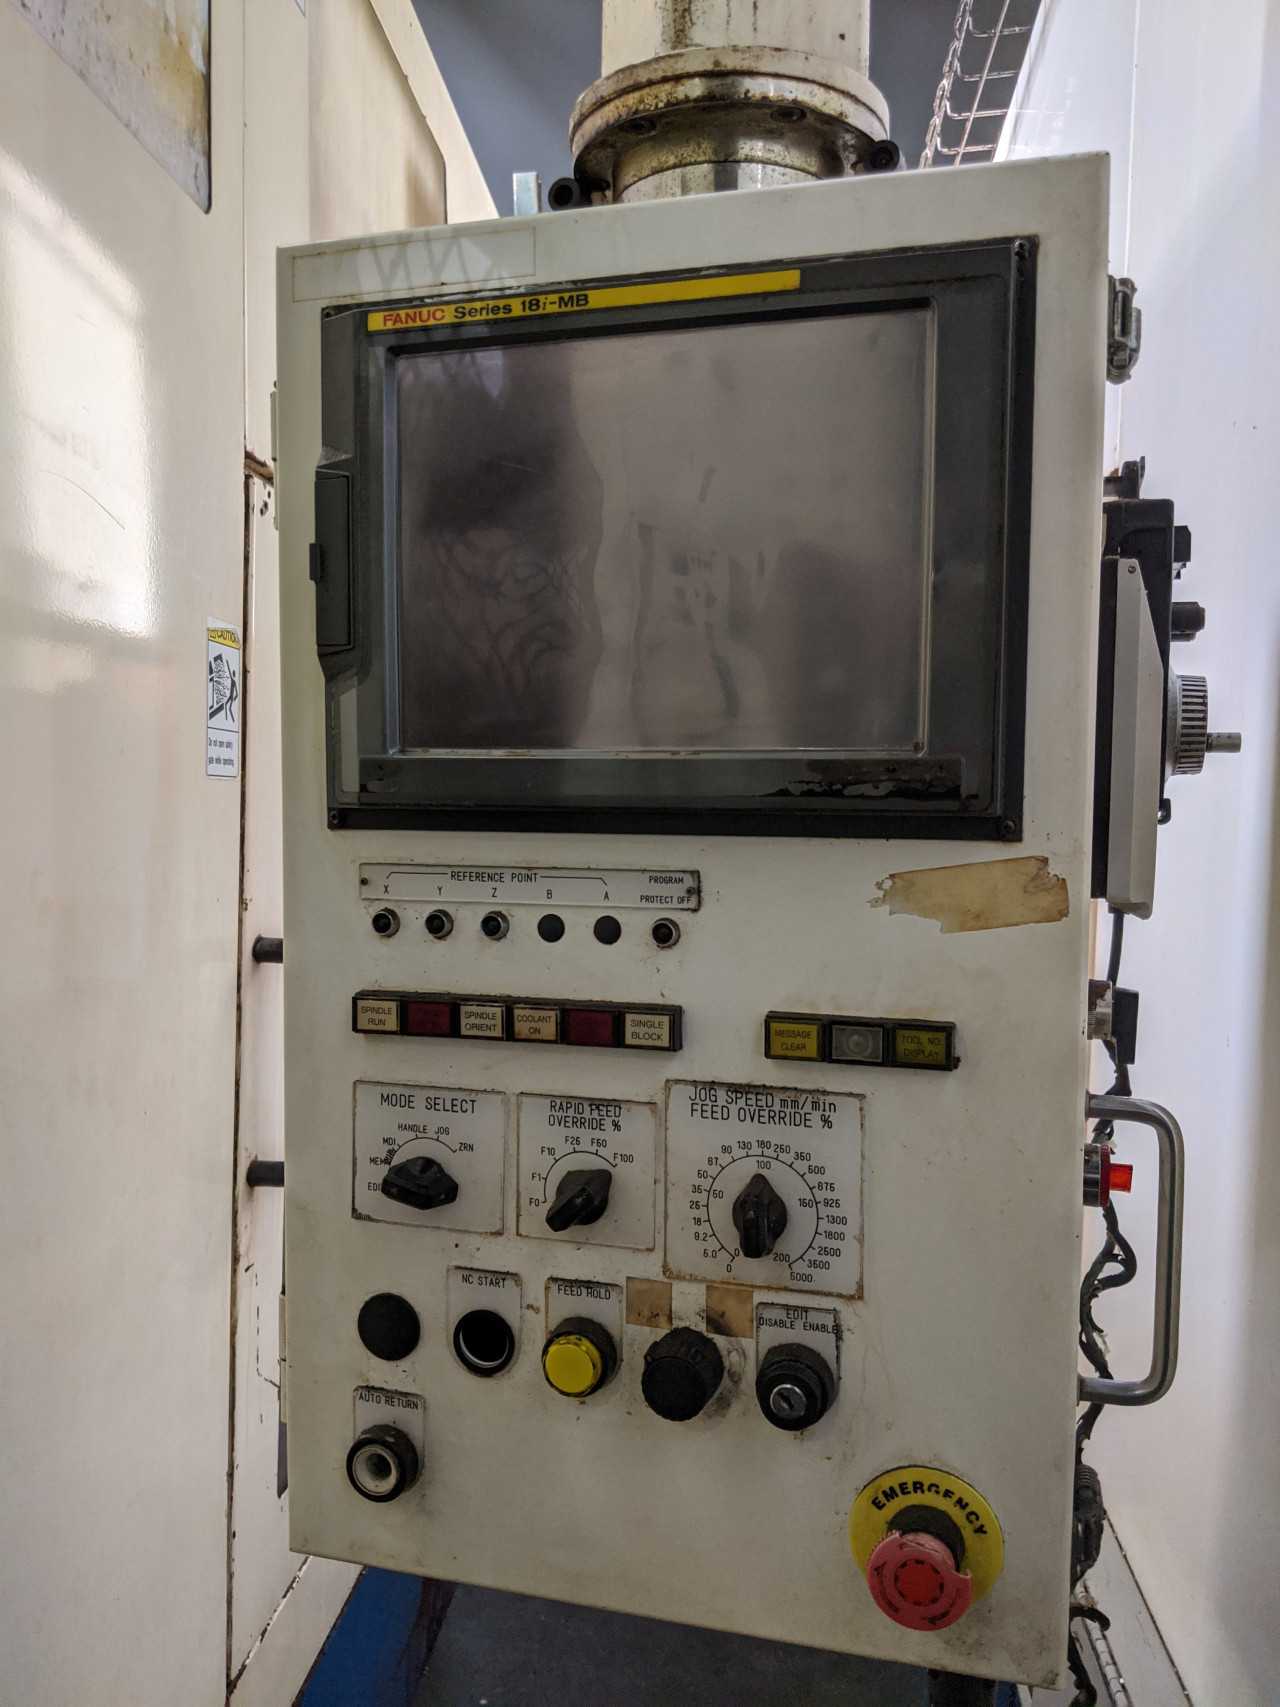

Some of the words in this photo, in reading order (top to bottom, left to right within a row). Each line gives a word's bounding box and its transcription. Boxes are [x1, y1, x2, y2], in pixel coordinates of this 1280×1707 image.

[382, 308, 446, 327] FANUC
[453, 302, 512, 320] Series
[520, 293, 589, 313] 18i-MB
[450, 872, 505, 883] REFERENCE
[511, 872, 538, 883] POINT
[649, 875, 684, 885] PROGRAM
[383, 885, 389, 894] X
[437, 886, 442, 896] Y
[491, 887, 497, 898] Z
[546, 889, 552, 899] B
[603, 891, 609, 901] A
[640, 895, 674, 905] PROTECT
[677, 896, 692, 905] OFF
[361, 1006, 393, 1016] SPINDLE
[464, 1011, 497, 1021] SPINDLE
[367, 1017, 386, 1027] RUN
[516, 1014, 551, 1024] COOLANT
[464, 1023, 497, 1033] ORIENT
[630, 1019, 664, 1030] SINGLE
[528, 1026, 541, 1035] ON
[631, 1031, 664, 1042] BLOCK
[781, 1041, 807, 1052] CLEAR
[380, 1093, 415, 1109] MODE
[425, 1096, 477, 1114] SELECT
[689, 1087, 718, 1103] JOG
[726, 1089, 774, 1108] SPEED
[779, 1096, 837, 1113] mm/min
[550, 1100, 585, 1115] RAPID
[590, 1104, 622, 1118] FEED
[690, 1102, 730, 1121] FEED
[738, 1107, 813, 1128] OVERRIDE
[820, 1114, 833, 1129] %
[548, 1114, 606, 1132] OVERRIDE
[612, 1119, 622, 1132] %
[398, 1123, 428, 1134] HANDLE
[435, 1126, 450, 1135] JOG
[383, 1137, 396, 1146] MDI
[737, 1141, 752, 1150] 130
[756, 1140, 771, 1149] 180
[459, 1142, 474, 1152] ZRN
[541, 1146, 556, 1156] F10
[613, 1153, 634, 1163] F100
[756, 1160, 771, 1170] 100
[532, 1172, 541, 1182] F1
[826, 1215, 847, 1226] 1300
[773, 1252, 790, 1262] 200
[462, 1274, 474, 1284] NC
[478, 1276, 506, 1288] START
[557, 1284, 582, 1297] FEED
[587, 1287, 611, 1300] HOLD
[786, 1309, 808, 1320] EDIT
[759, 1316, 796, 1330] DISABLE
[803, 1321, 838, 1335] ENABLE
[358, 1391, 381, 1404] AUTO
[385, 1395, 419, 1409] RETURN
[871, 1481, 988, 1536] EMERGENCY
